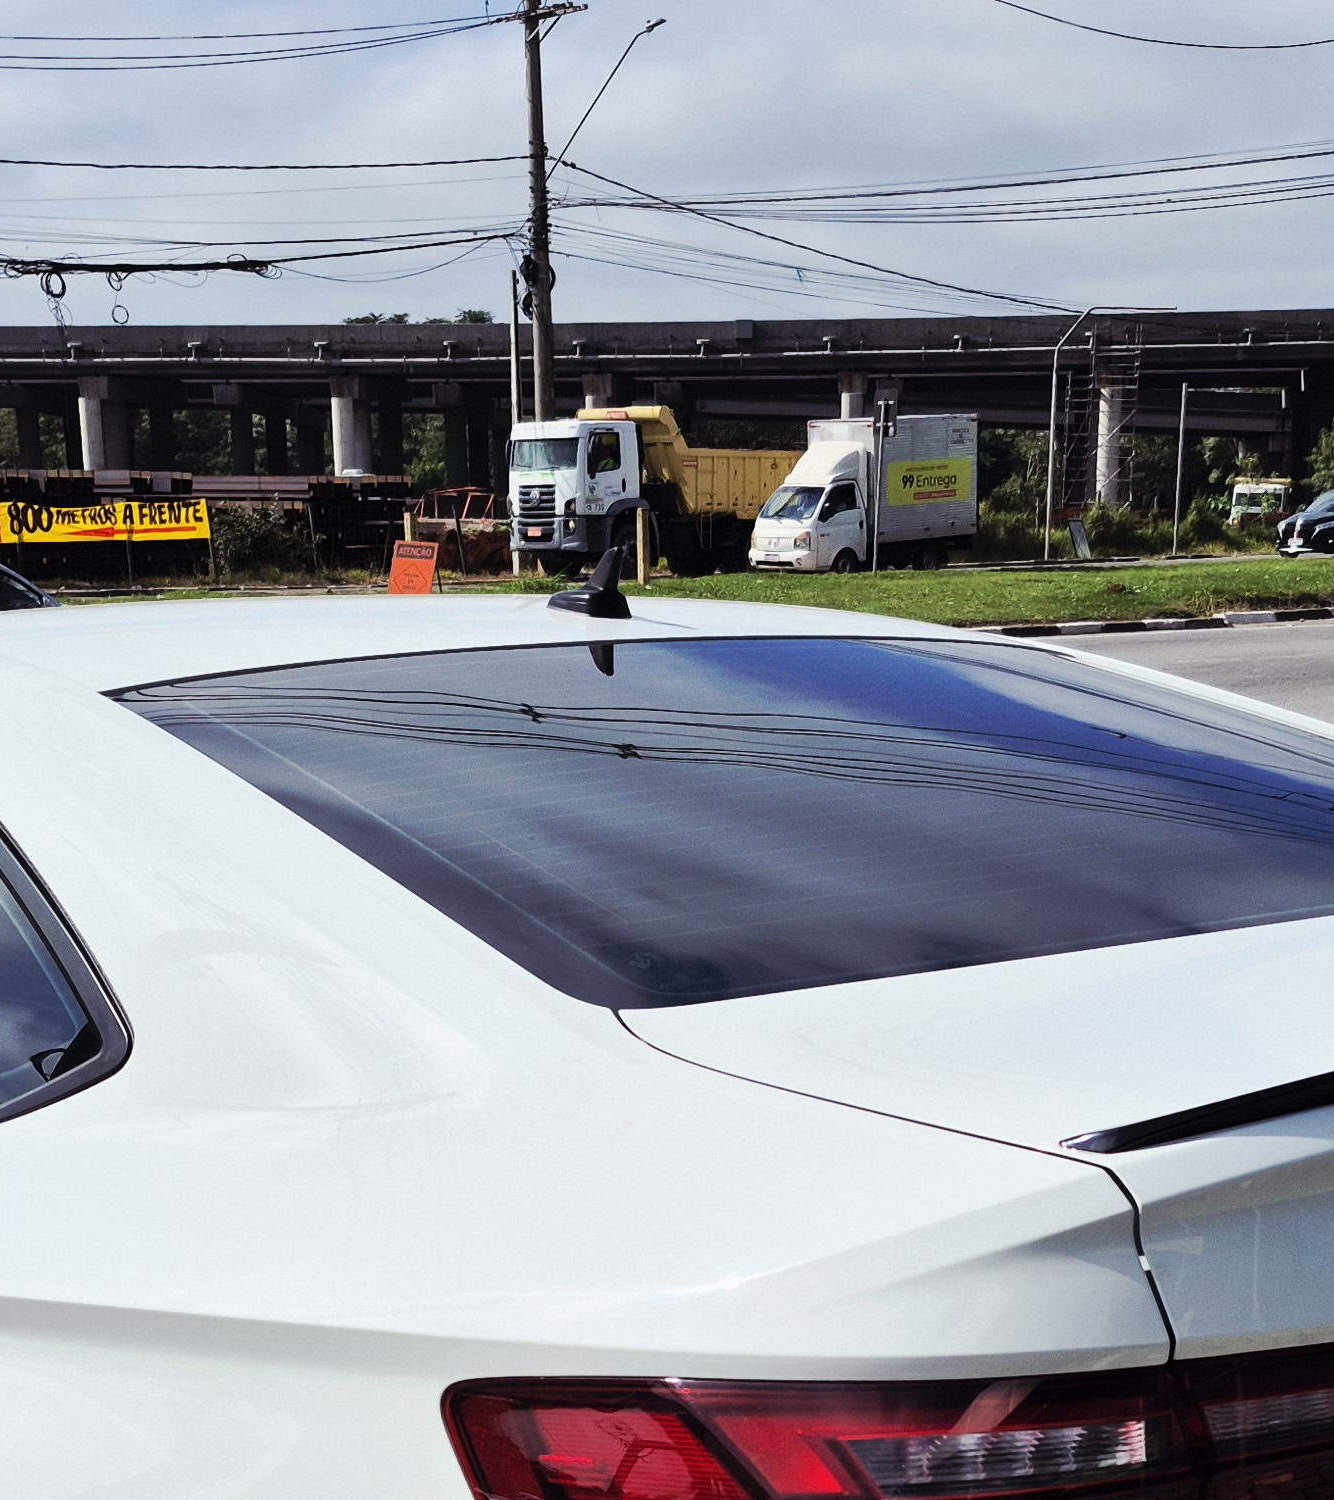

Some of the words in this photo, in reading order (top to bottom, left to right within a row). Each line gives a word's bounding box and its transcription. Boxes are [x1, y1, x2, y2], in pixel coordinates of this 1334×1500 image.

[901, 475, 915, 489] 99
[915, 475, 957, 489] Entrega
[7, 501, 54, 535] 800
[55, 505, 117, 526] METROS
[123, 503, 135, 525] A
[138, 500, 204, 525] FRENTE
